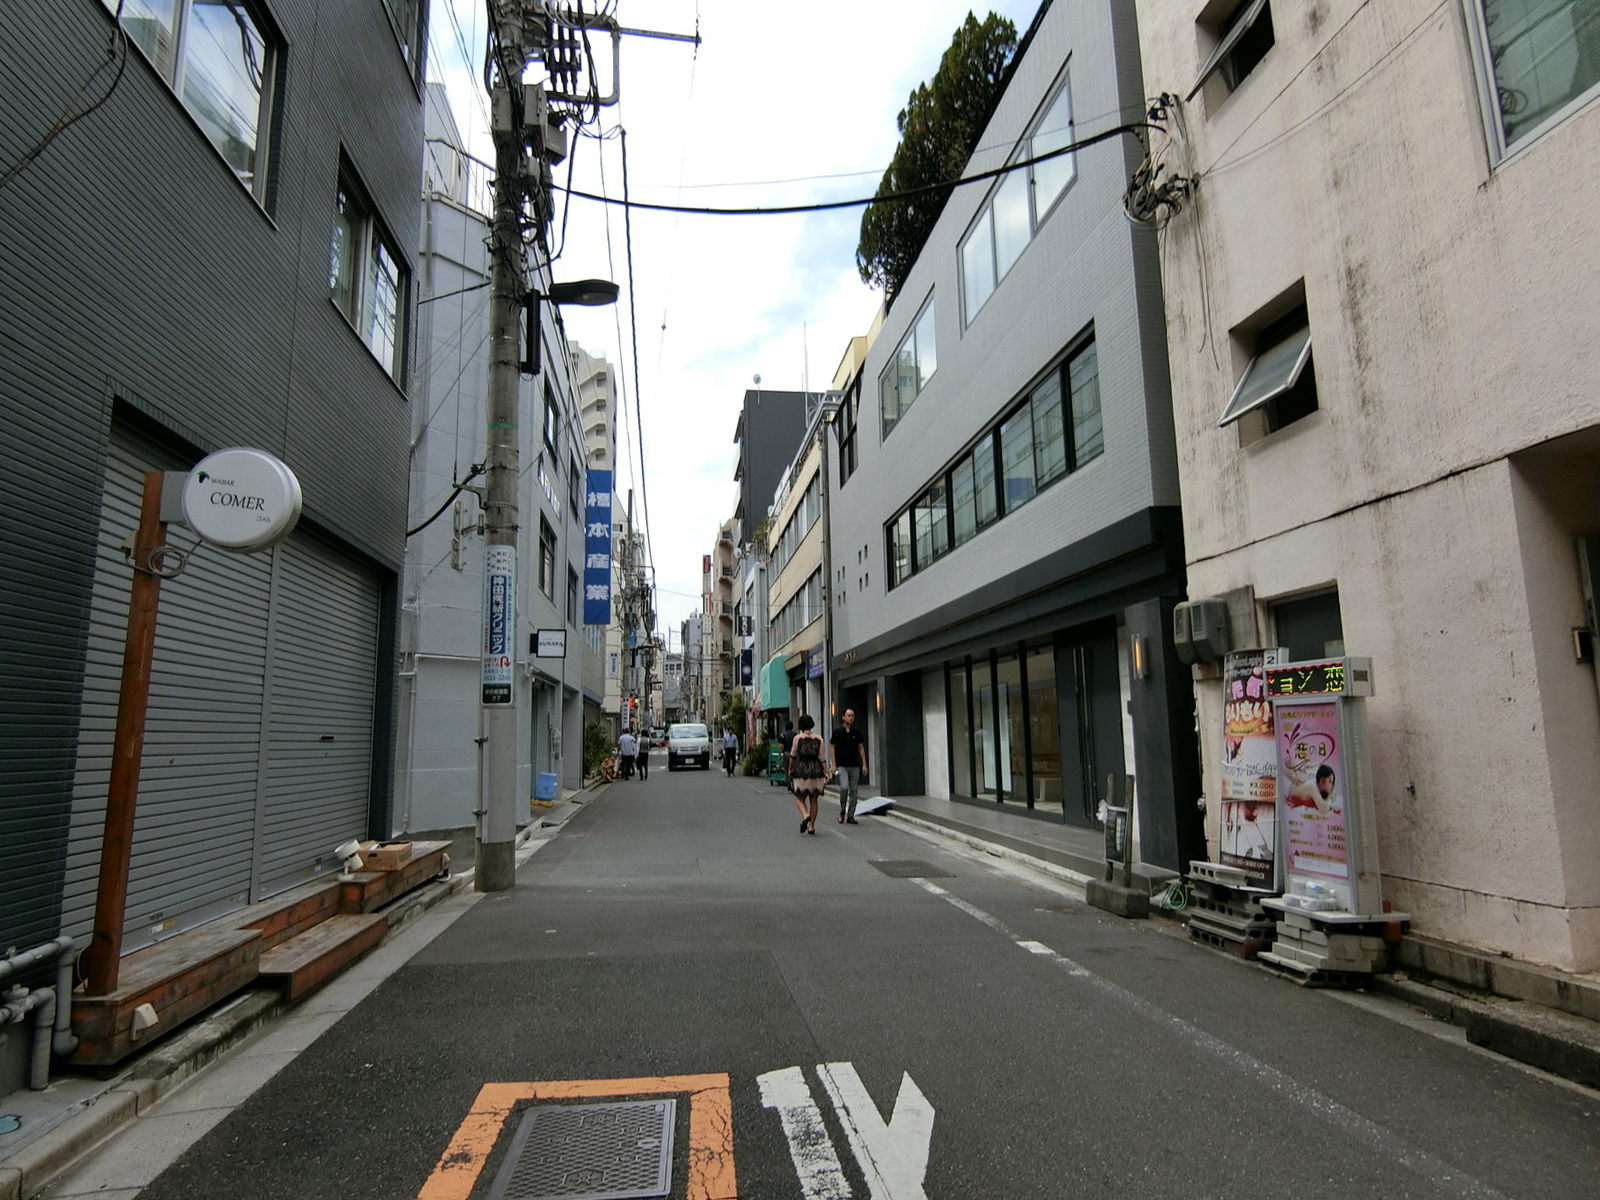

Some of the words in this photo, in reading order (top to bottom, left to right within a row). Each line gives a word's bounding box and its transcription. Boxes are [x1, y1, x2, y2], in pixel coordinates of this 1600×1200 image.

[211, 478, 235, 486] WABAR
[210, 491, 265, 511] COMER
[256, 515, 271, 523] コメル
[1266, 655, 1275, 664] 2
